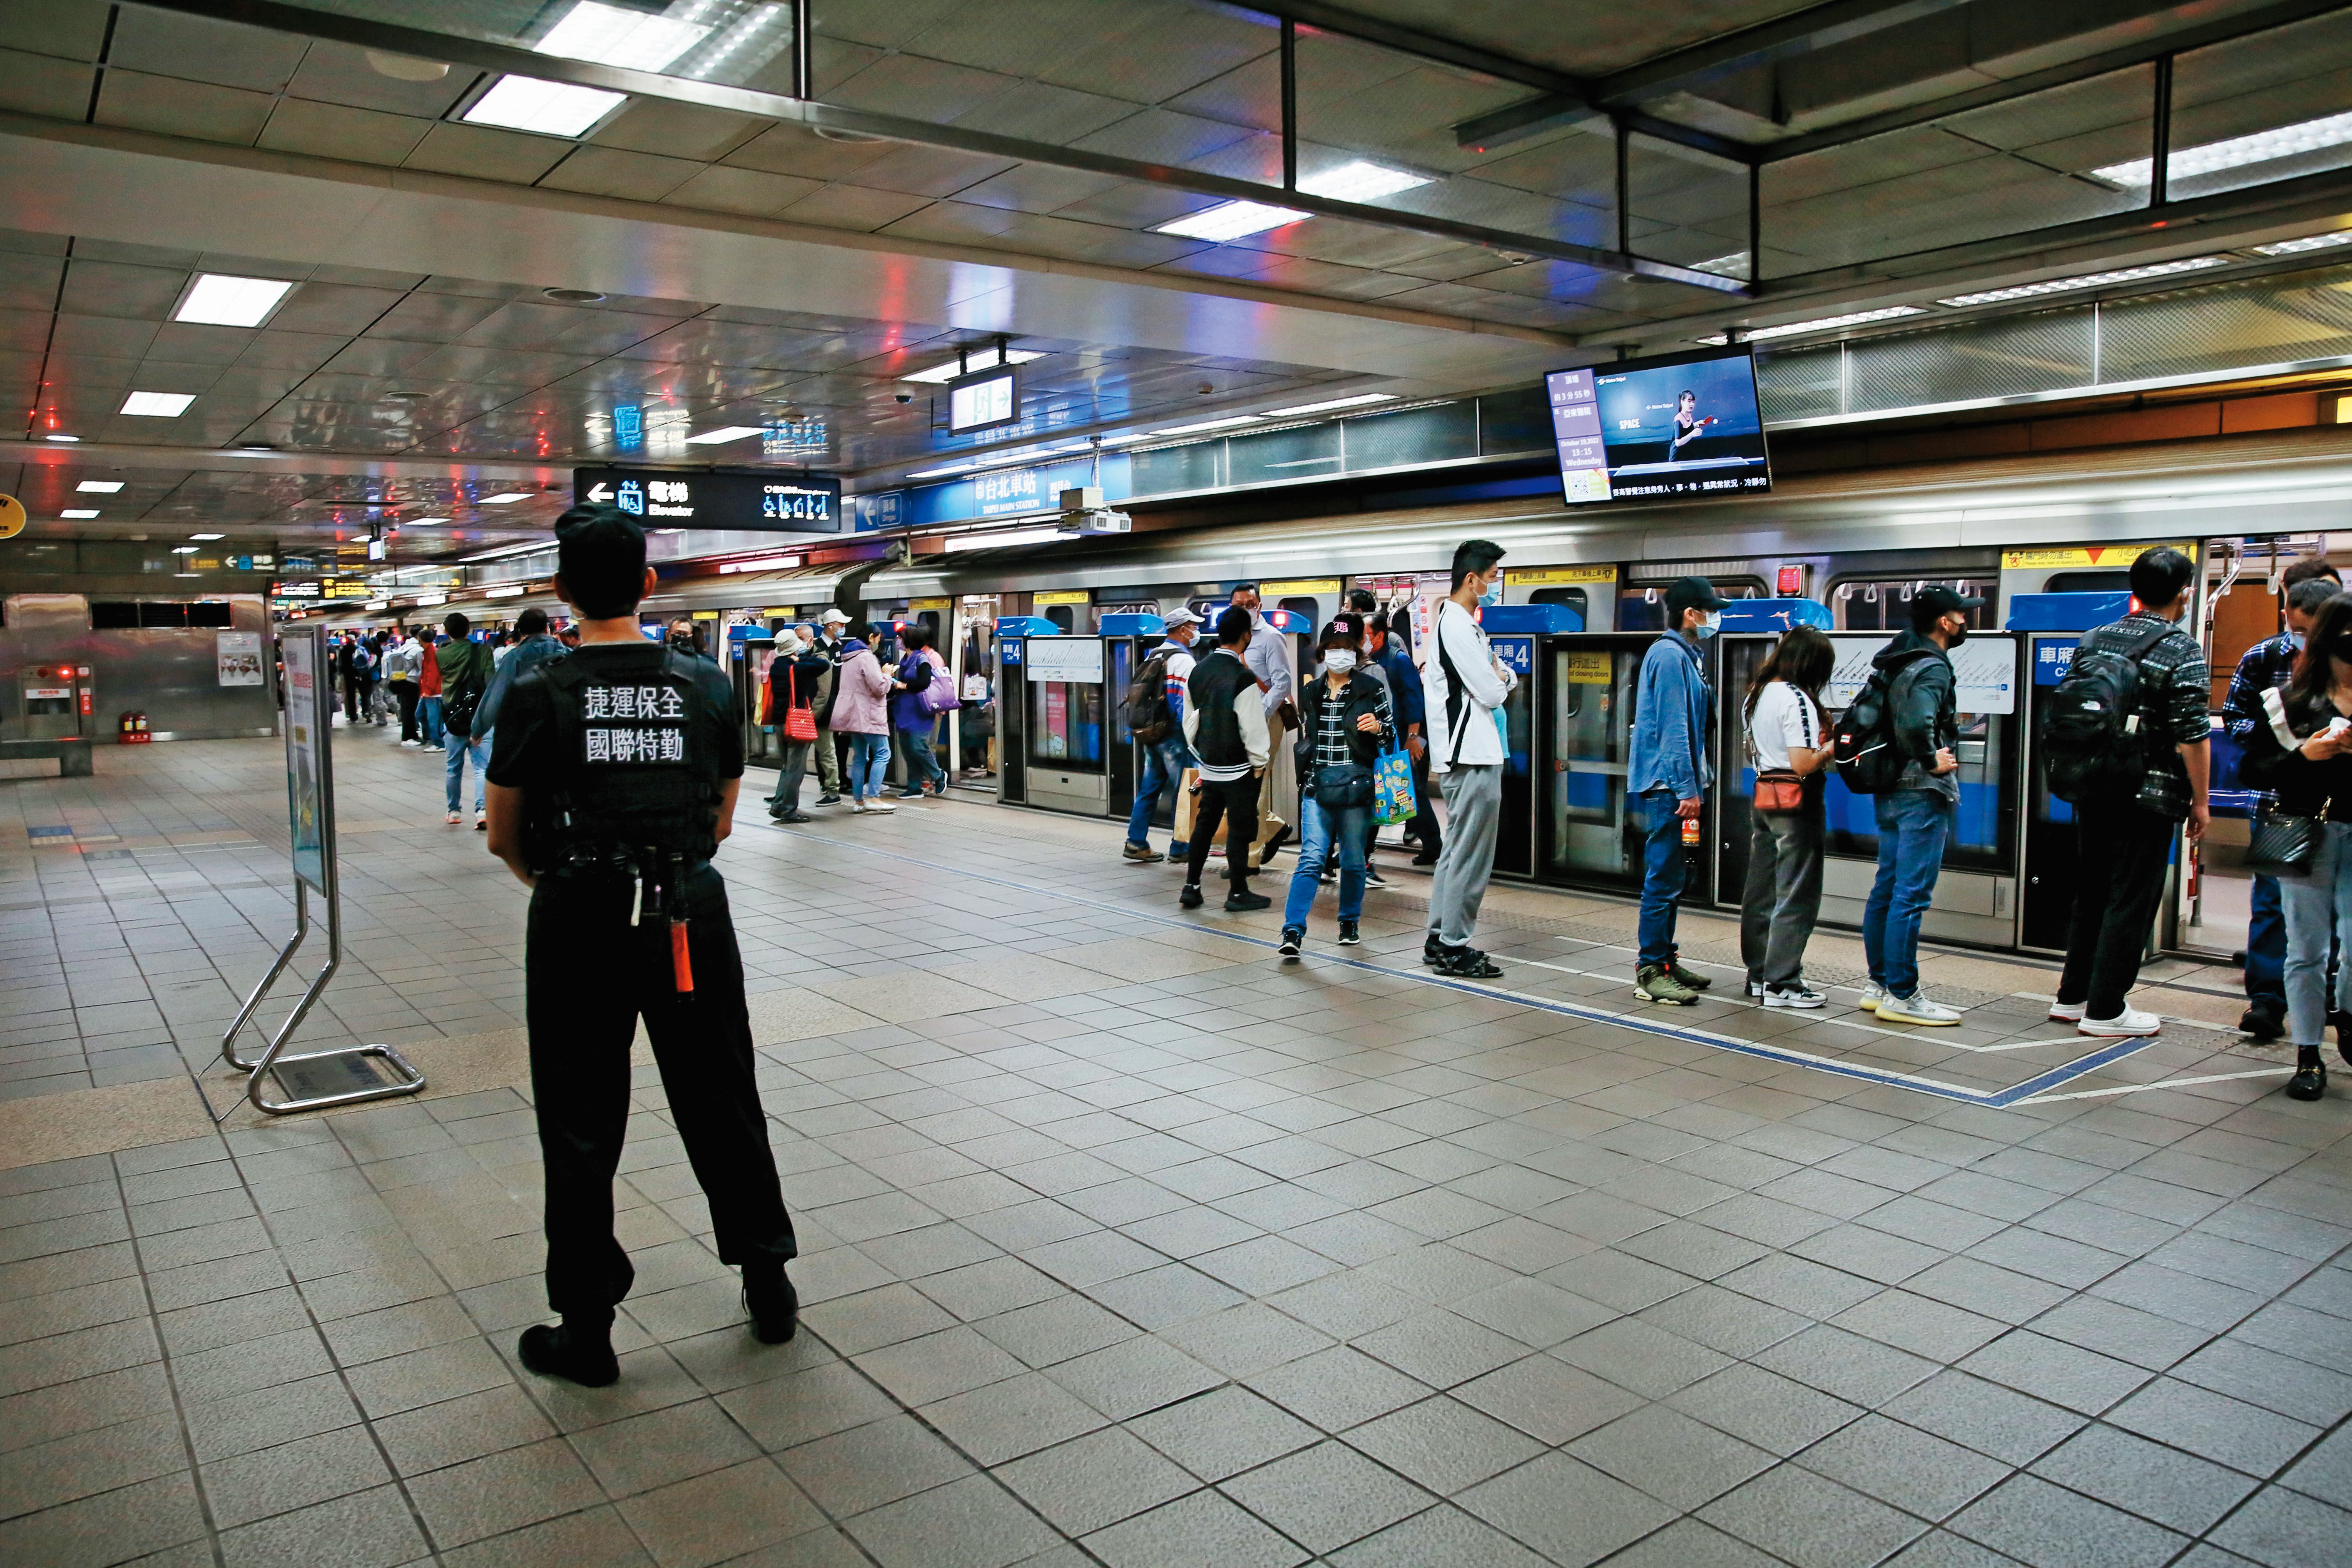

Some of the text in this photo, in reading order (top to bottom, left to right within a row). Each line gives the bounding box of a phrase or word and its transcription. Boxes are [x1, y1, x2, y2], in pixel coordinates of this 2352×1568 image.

[1574, 390, 1583, 398] 55
[1619, 418, 1641, 430] SPACE
[1565, 457, 1602, 467] Wednesday
[985, 470, 1037, 501] 台北車站
[648, 504, 694, 517] Elevator
[983, 498, 1040, 515] TAIPEI MAIN STATION
[739, 645, 743, 657] 3
[1013, 645, 1020, 660] 4
[1493, 645, 1514, 658] 車廂
[1515, 645, 1528, 667] 4
[585, 686, 684, 719] 捷運保全
[586, 728, 683, 762] 國聯特勤
